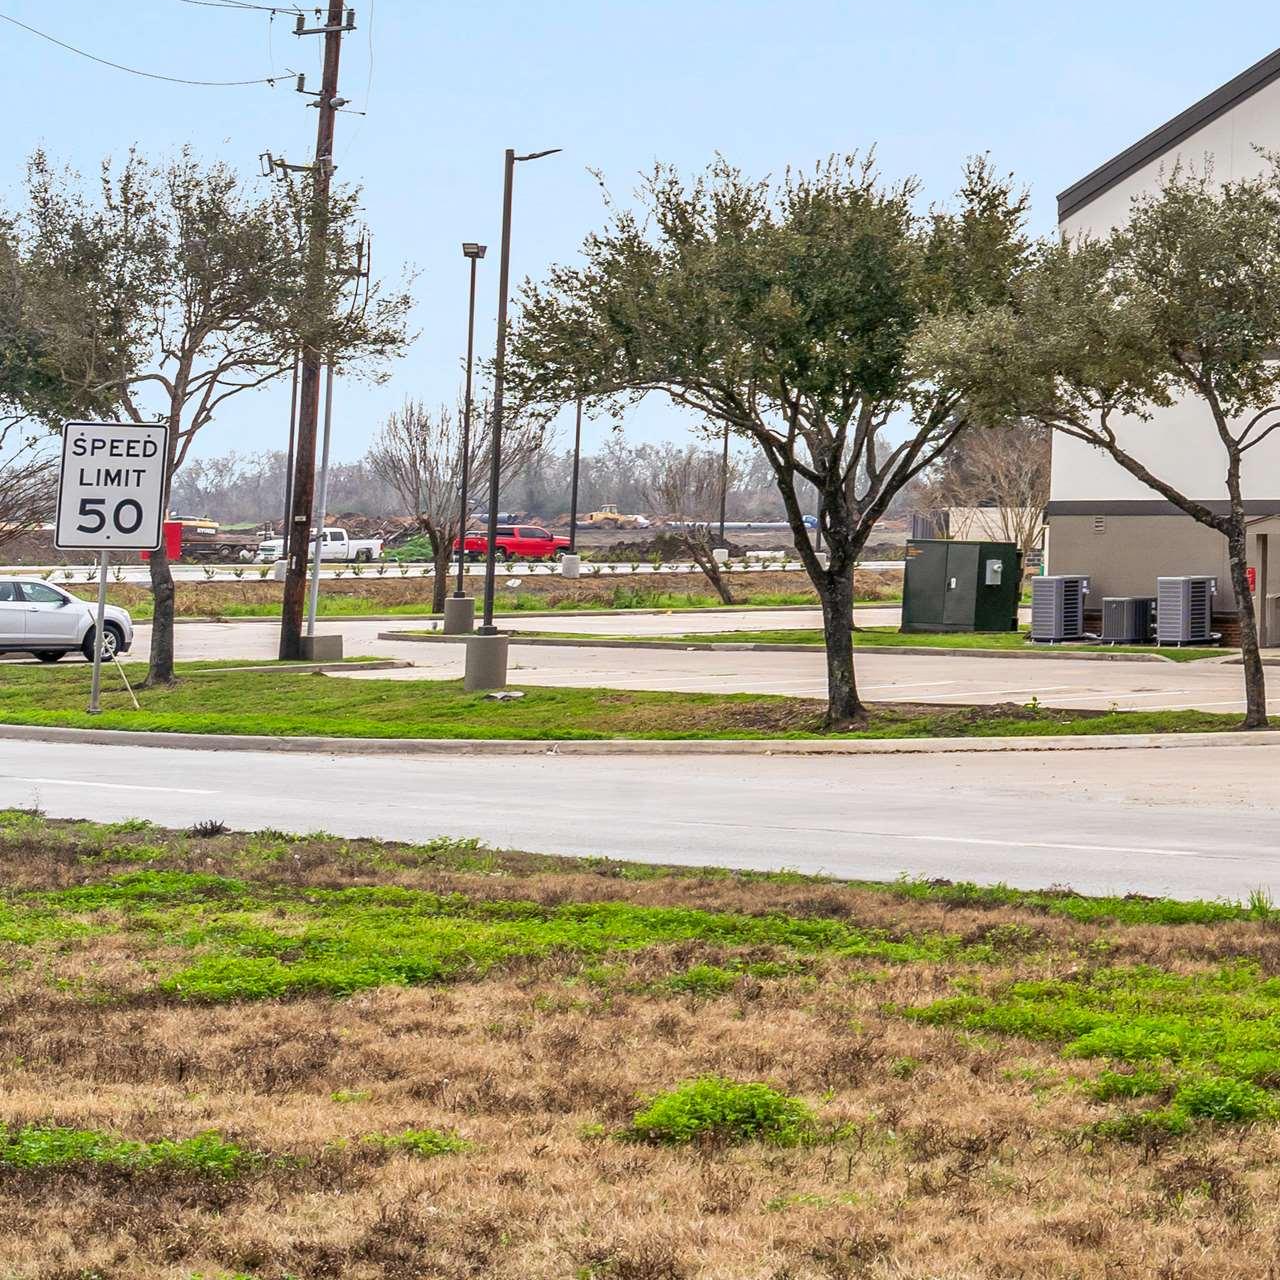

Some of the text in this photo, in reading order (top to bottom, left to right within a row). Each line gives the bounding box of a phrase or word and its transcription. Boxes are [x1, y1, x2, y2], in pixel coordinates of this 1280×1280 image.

[72, 437, 158, 458] SPEED
[79, 468, 146, 487] LIMIT
[76, 498, 143, 534] 50
